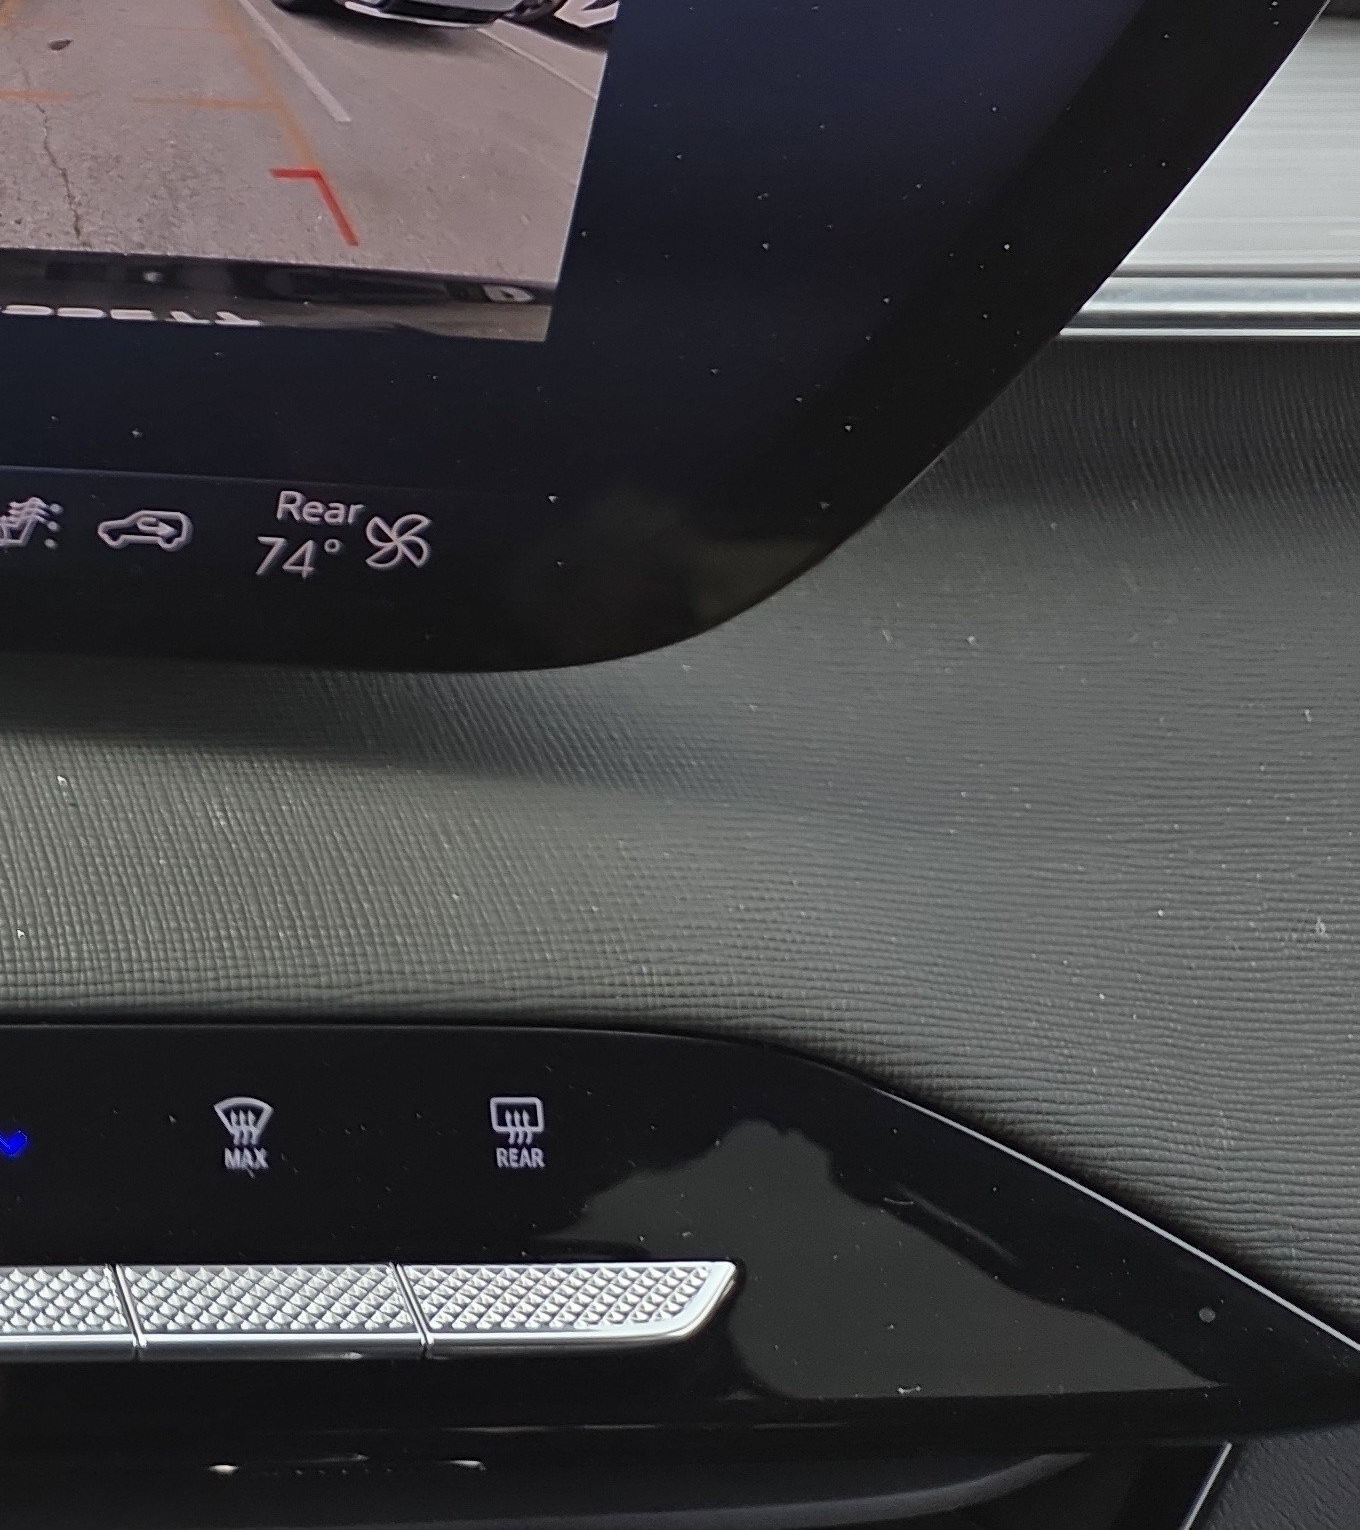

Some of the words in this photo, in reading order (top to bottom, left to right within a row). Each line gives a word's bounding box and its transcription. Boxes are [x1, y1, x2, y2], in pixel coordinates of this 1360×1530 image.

[276, 490, 364, 525] Rear
[255, 536, 343, 578] 74°
[224, 1147, 269, 1169] MAX
[495, 1146, 546, 1169] REAR
